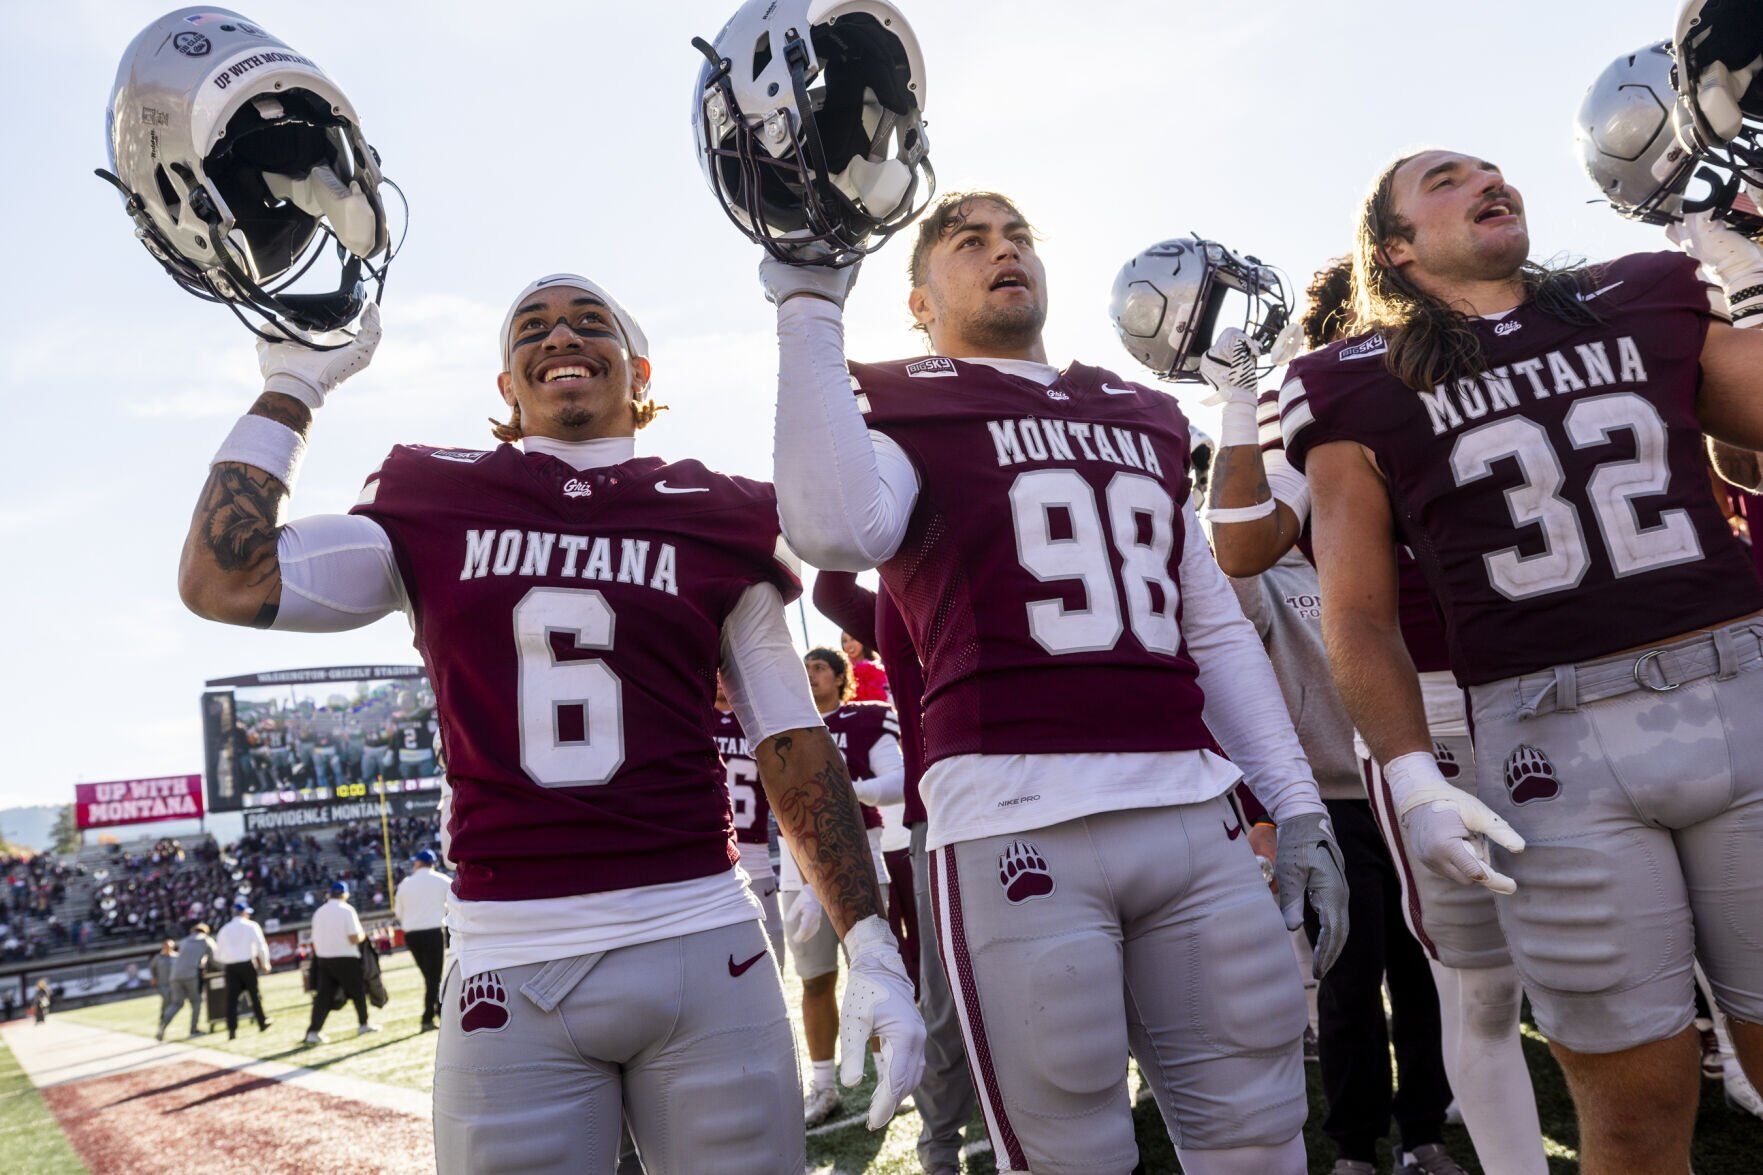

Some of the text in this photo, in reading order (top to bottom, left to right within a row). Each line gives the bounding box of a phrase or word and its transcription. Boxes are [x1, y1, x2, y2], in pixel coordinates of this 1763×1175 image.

[213, 72, 231, 90] UP
[228, 54, 263, 79] WITH
[1494, 320, 1522, 335] Griz
[1417, 336, 1648, 435] MONTANA
[986, 418, 1164, 478] MONTANA
[563, 478, 592, 498] Griz
[1449, 391, 1705, 602] 32
[459, 529, 679, 596] MONTANA
[1008, 468, 1181, 656] 98
[374, 666, 419, 677] STADIUM
[512, 586, 625, 788] 6
[95, 778, 189, 802] UP WITH
[727, 758, 758, 829] 6
[997, 795, 1041, 807] NIKE PRO
[88, 796, 198, 824] MONTANA
[247, 807, 329, 829] PROVIDENCE
[331, 801, 393, 822] MONTANA
